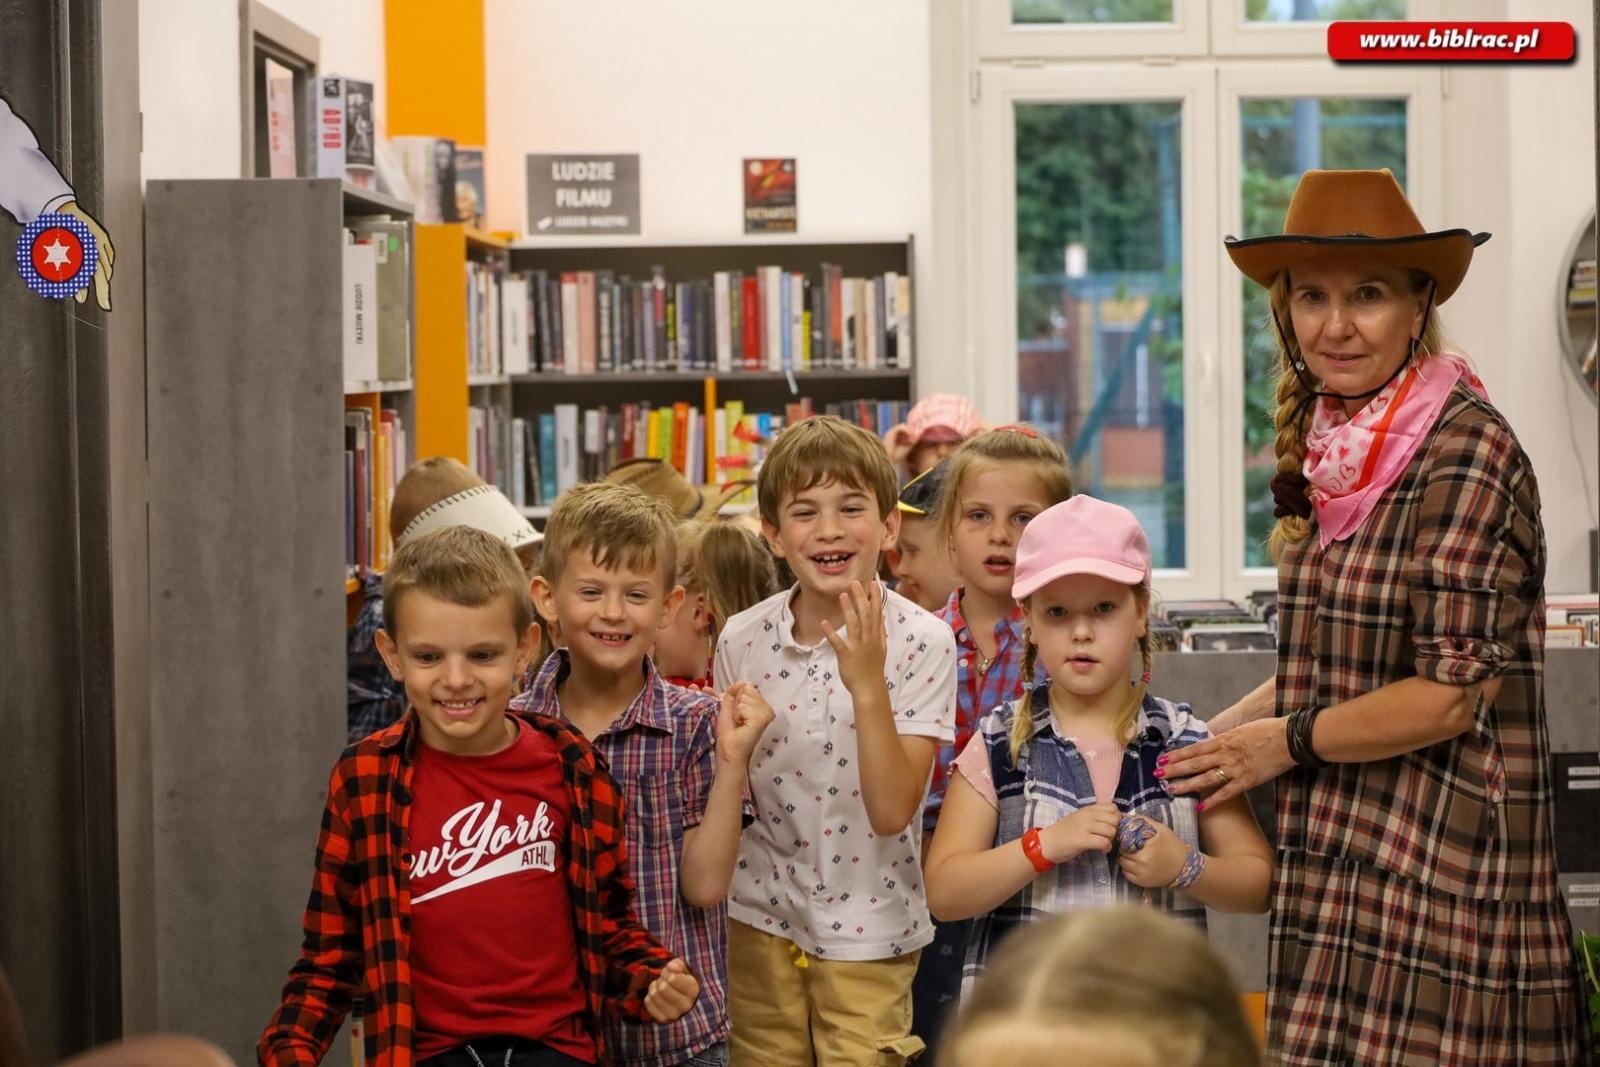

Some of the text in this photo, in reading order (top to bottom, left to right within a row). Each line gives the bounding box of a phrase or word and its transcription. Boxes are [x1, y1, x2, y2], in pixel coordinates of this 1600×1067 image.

[551, 161, 616, 181] LUDZIE
[556, 188, 612, 208] FILMU
[355, 283, 364, 345] LUDZIE MUZYKI
[441, 799, 554, 877] York
